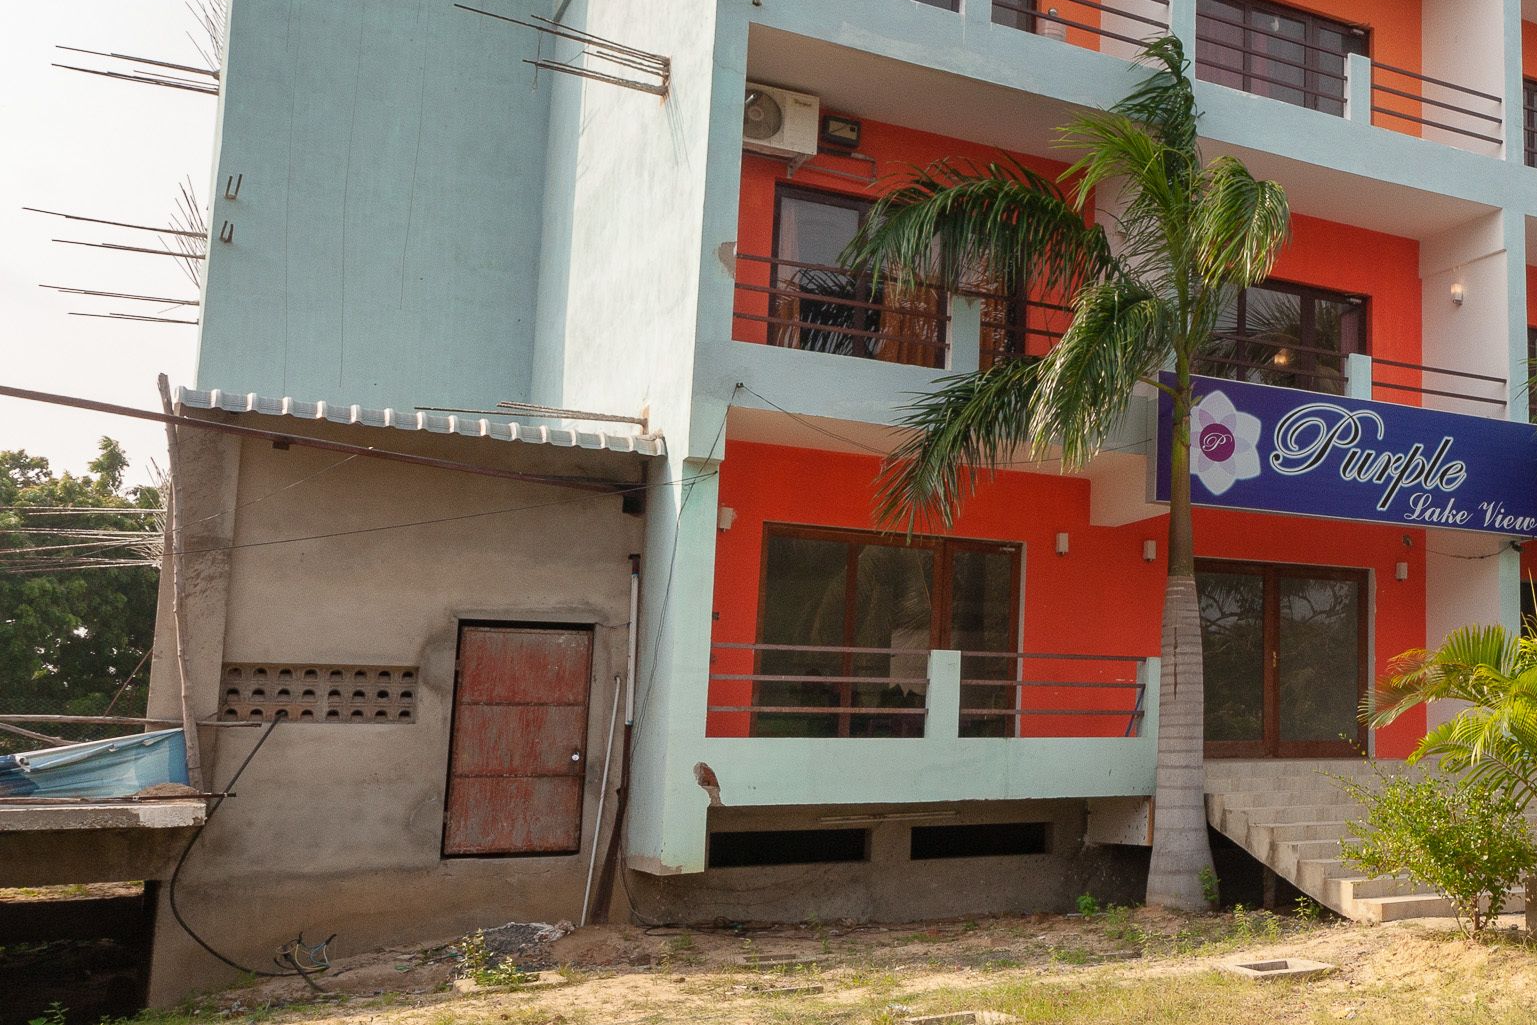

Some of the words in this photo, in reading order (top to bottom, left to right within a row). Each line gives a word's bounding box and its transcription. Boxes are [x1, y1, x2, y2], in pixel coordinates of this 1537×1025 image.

[1202, 432, 1233, 452] P
[1270, 402, 1467, 511] Purple
[1403, 492, 1474, 525] Lake
